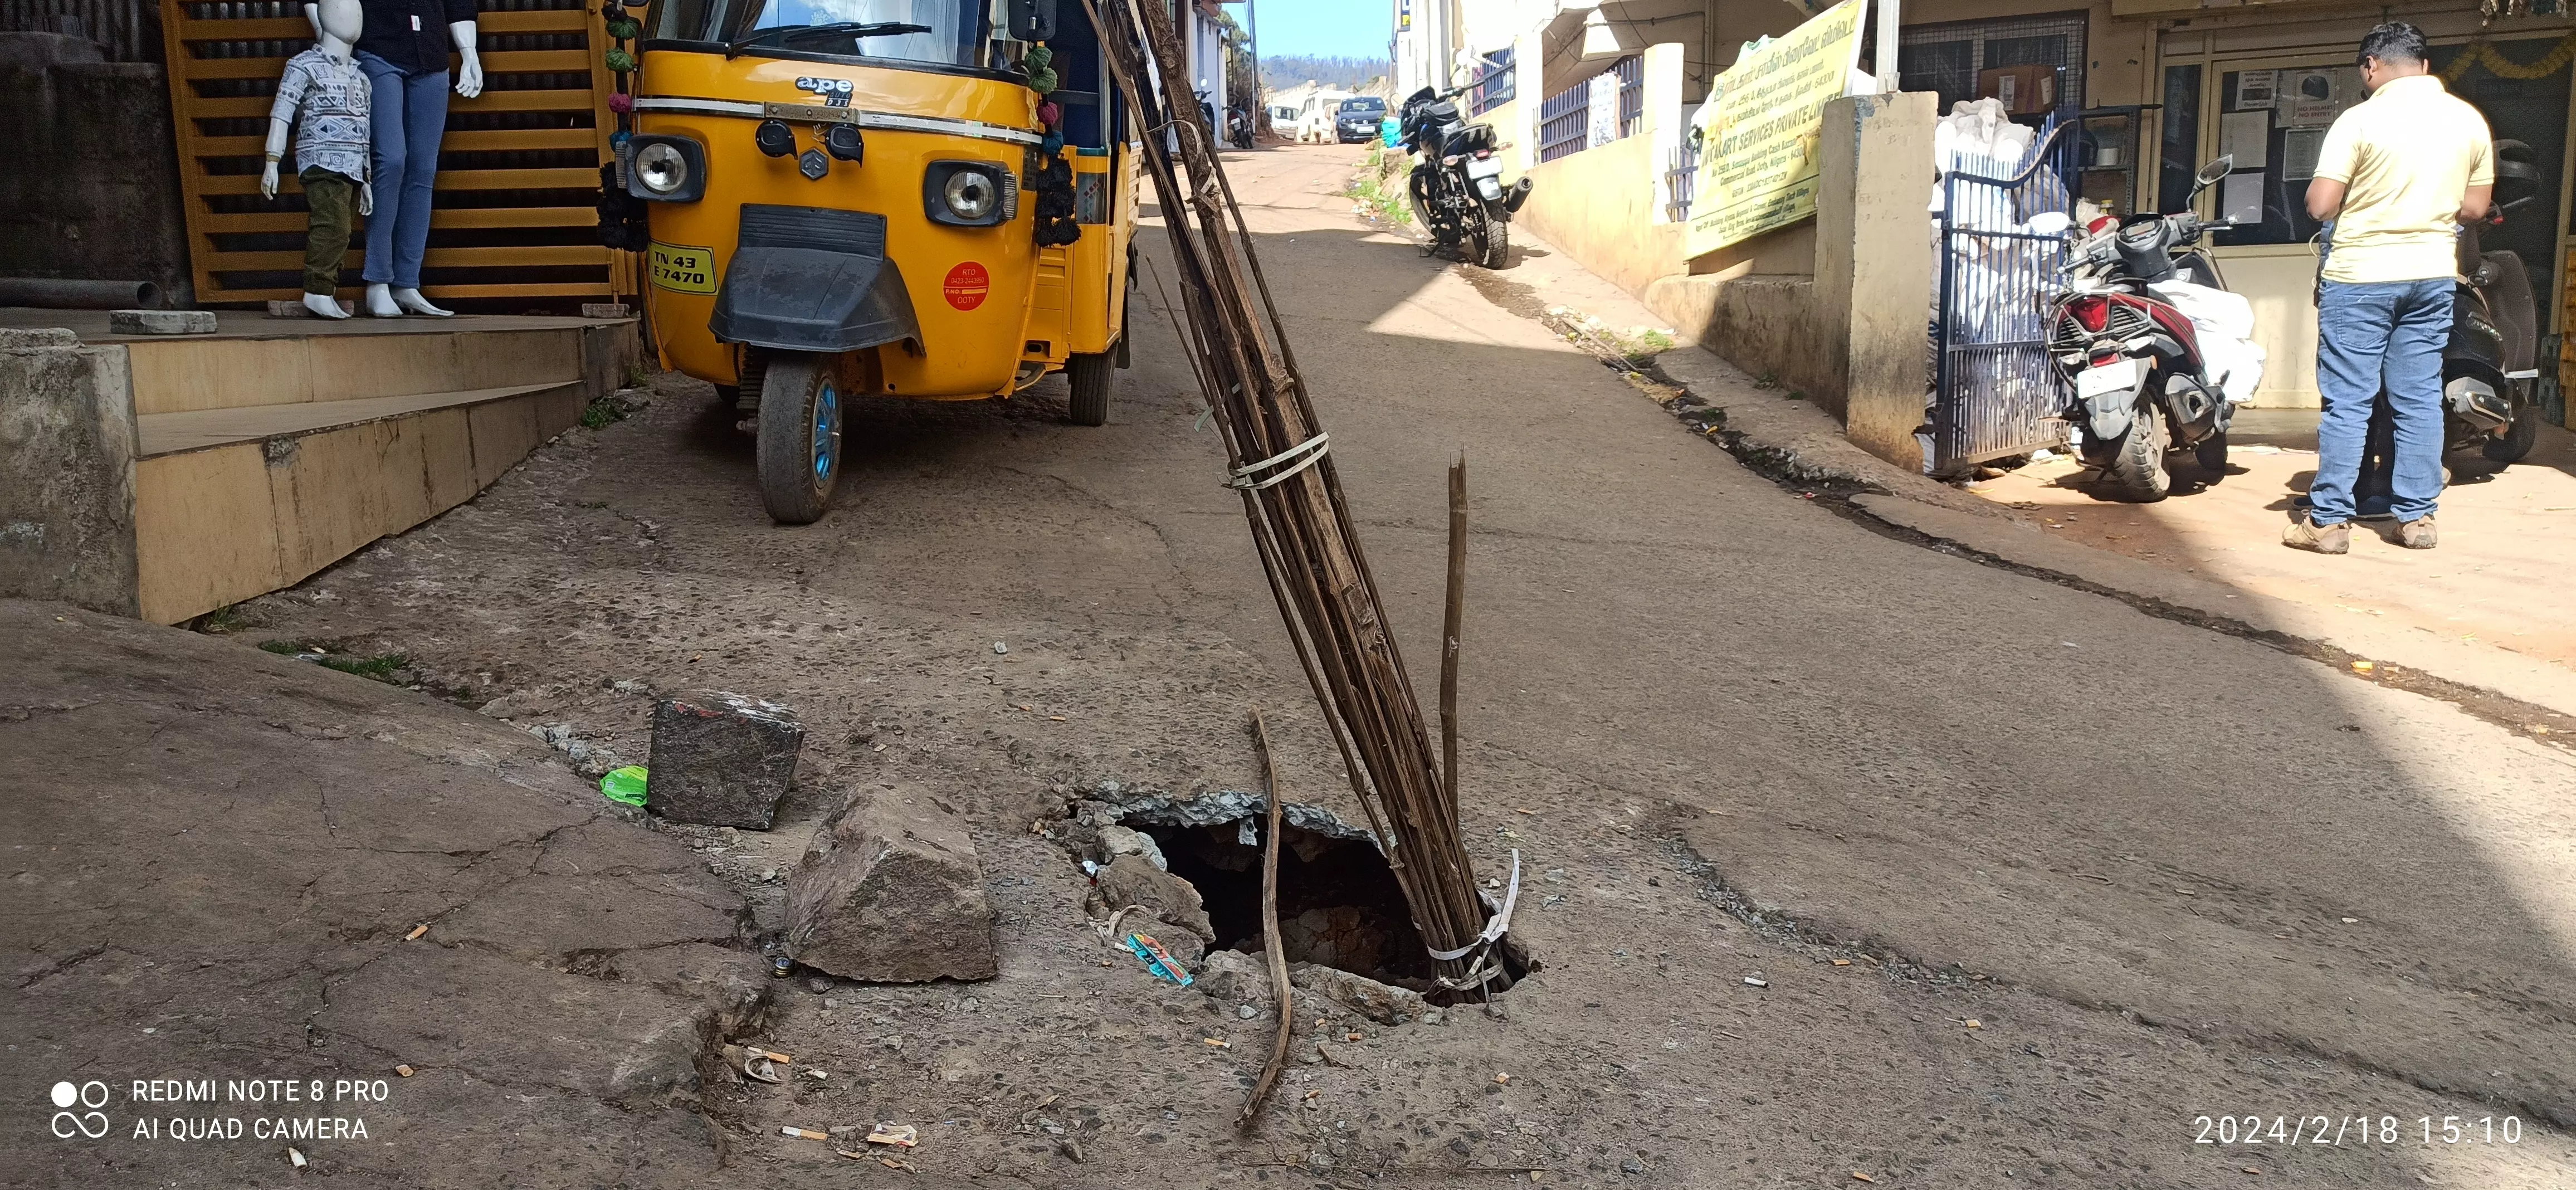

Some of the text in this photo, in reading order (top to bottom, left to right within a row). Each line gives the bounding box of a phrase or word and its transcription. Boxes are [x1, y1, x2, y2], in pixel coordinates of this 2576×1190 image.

[797, 77, 852, 93] ape
[1738, 120, 1774, 151] SERVICES
[1774, 105, 1809, 135] PRIVATE
[655, 251, 696, 269] TN 43
[654, 265, 704, 284] E 7470
